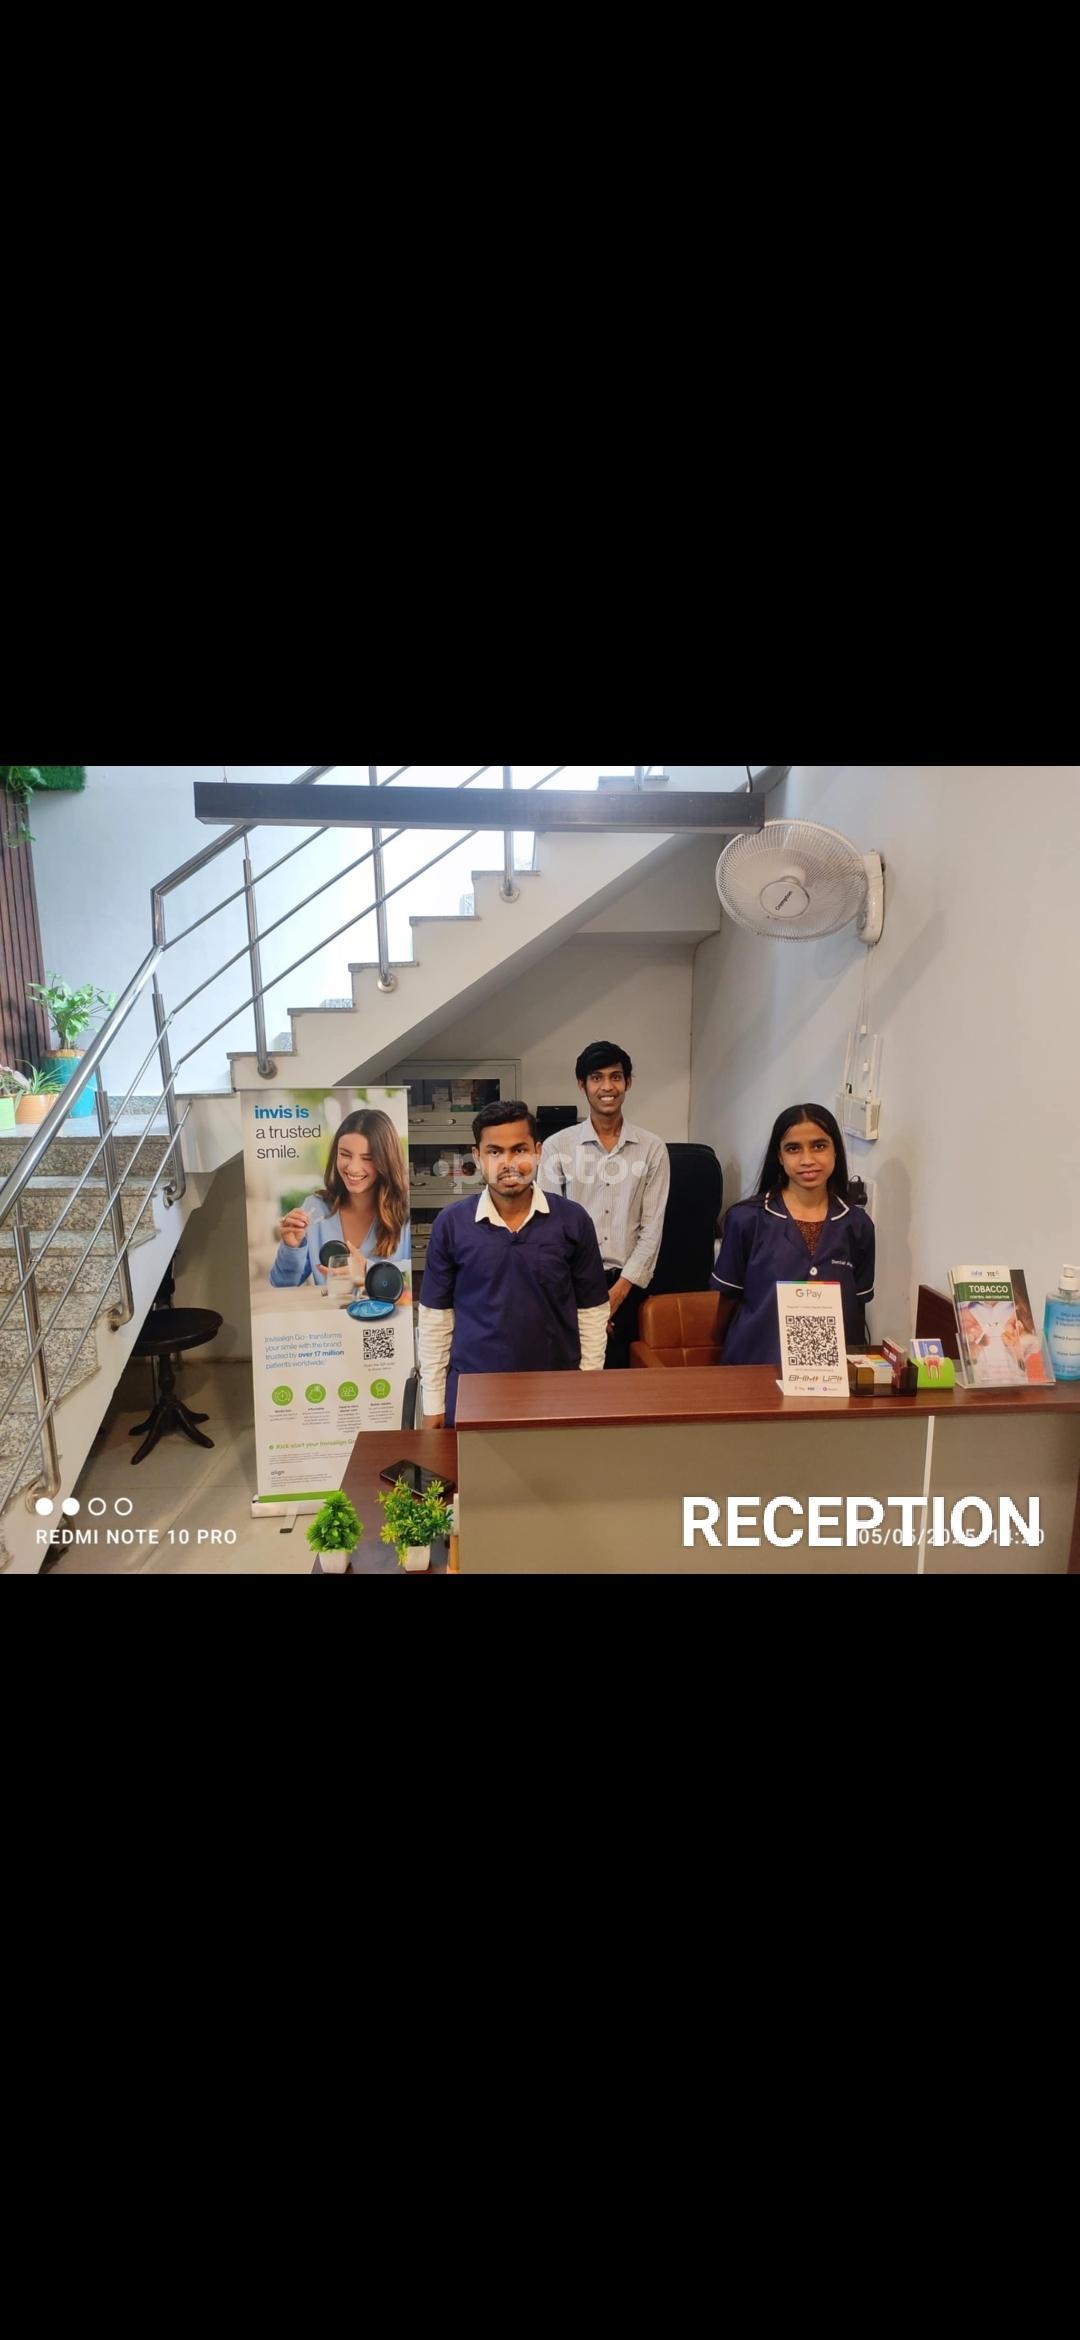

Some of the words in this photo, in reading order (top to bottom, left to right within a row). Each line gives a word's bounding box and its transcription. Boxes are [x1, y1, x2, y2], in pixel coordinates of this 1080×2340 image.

[254, 1105, 293, 1119] invis
[295, 1104, 310, 1118] is
[255, 1128, 266, 1139] a
[269, 1125, 321, 1139] trusted
[256, 1145, 300, 1159] smile.
[806, 1289, 822, 1300] Pay
[968, 1285, 1009, 1294] TOBACCO
